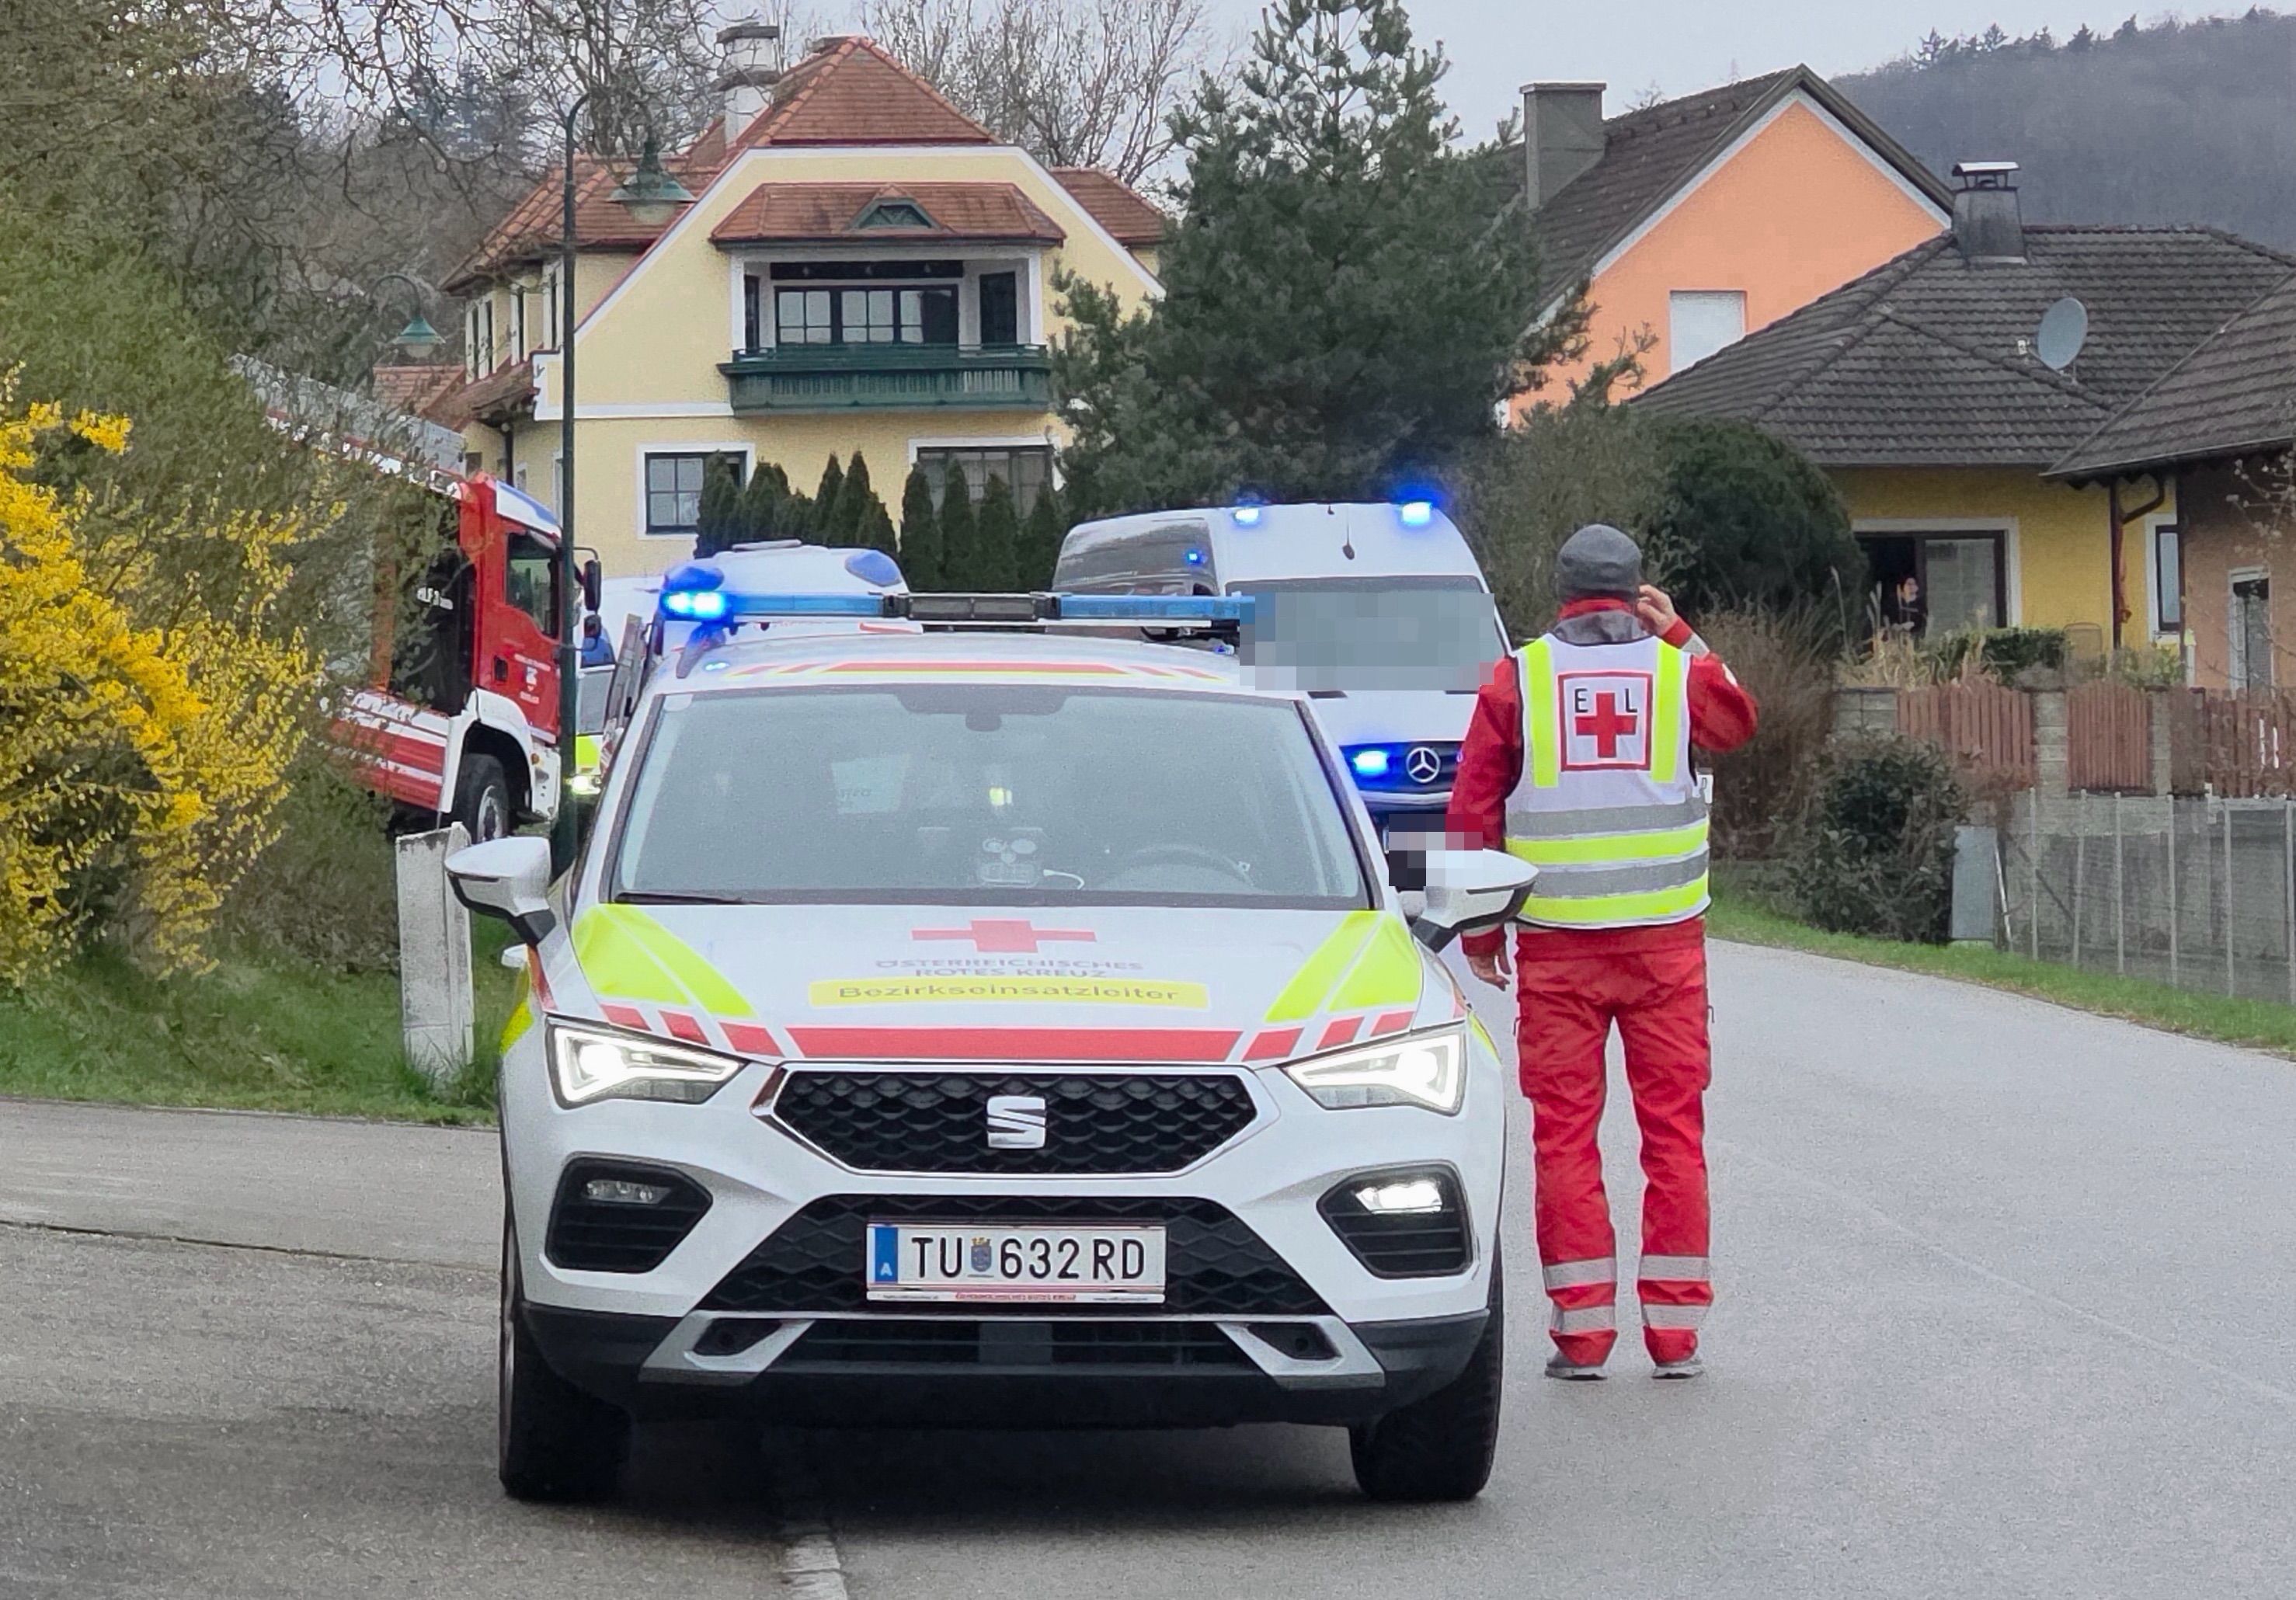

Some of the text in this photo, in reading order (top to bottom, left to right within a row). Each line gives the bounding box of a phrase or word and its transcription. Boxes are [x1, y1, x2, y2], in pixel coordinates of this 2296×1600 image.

[1574, 688, 1637, 712] E L
[915, 968, 1107, 977] ROTES KREUZ
[839, 985, 1179, 1000] Bezirkseinsatzleiter
[879, 1263, 892, 1276] A
[911, 1237, 963, 1278] TU
